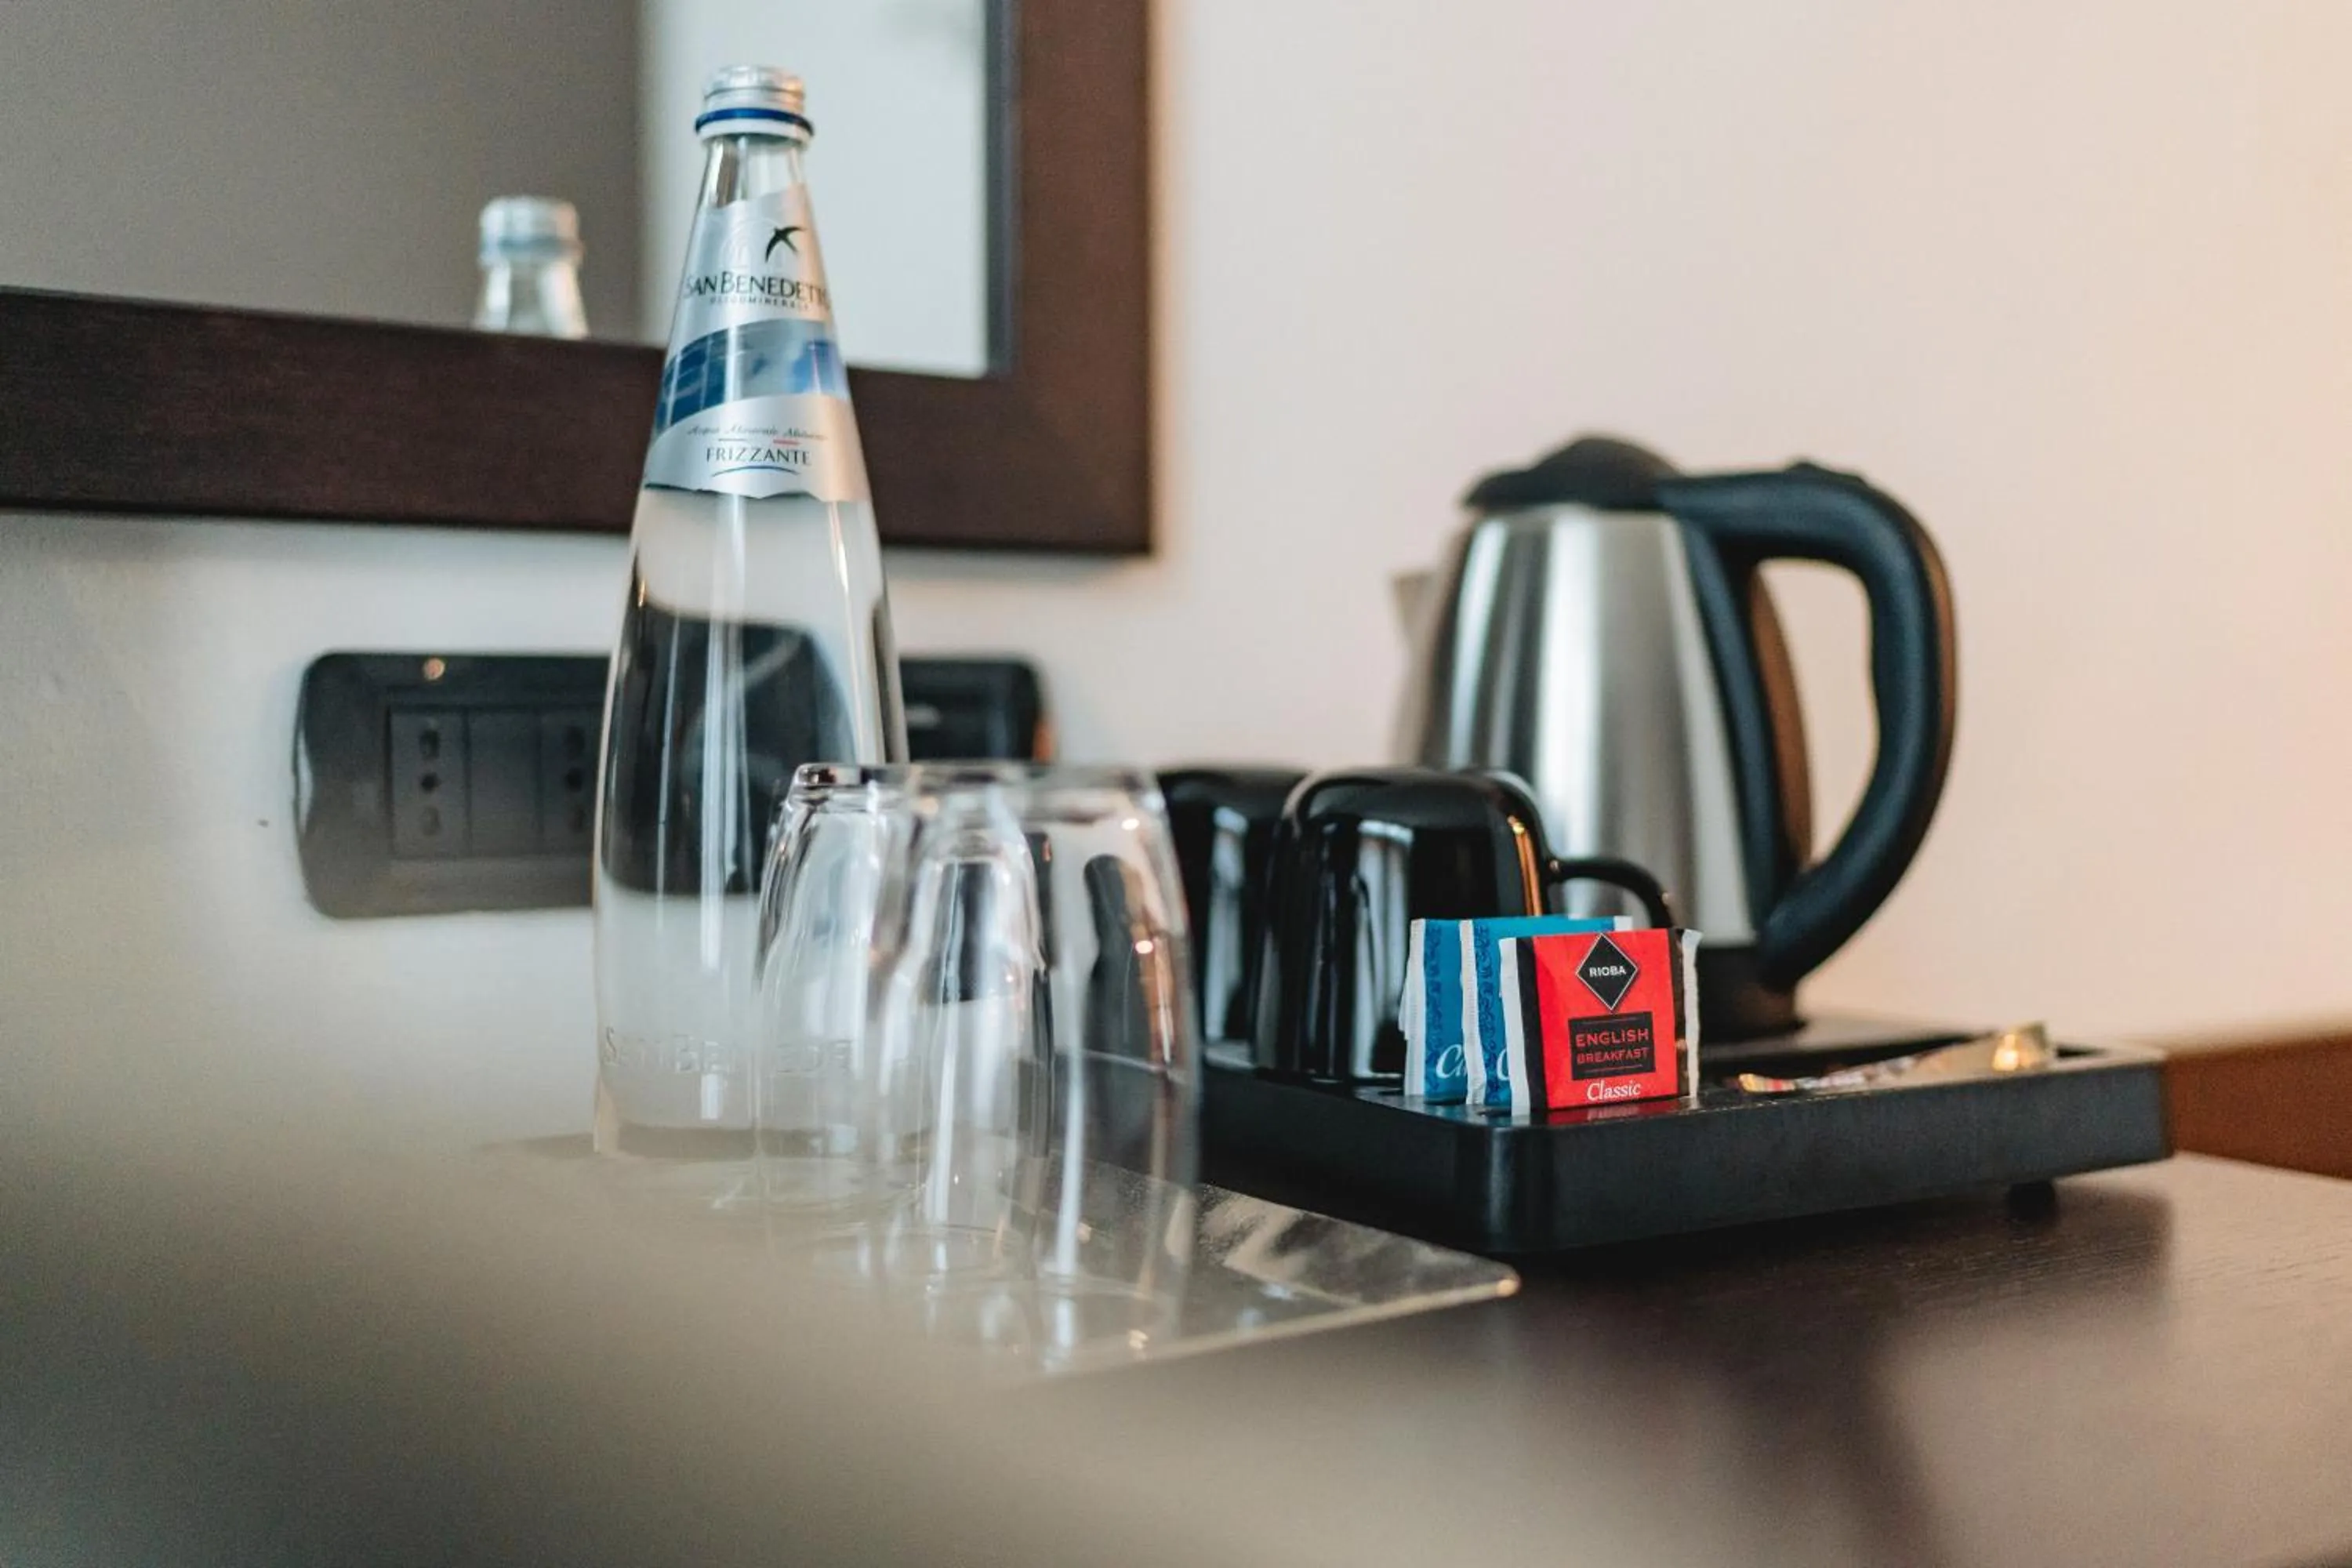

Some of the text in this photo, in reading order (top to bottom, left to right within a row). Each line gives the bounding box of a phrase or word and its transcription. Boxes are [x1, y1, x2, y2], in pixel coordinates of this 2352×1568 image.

[683, 274, 717, 299] SAN
[706, 448, 811, 466] FRIZZANTE
[1589, 965, 1627, 978] RIOBA
[1575, 1029, 1649, 1047] ENGLISH
[1577, 1047, 1649, 1065] BREAKFAST
[1587, 1080, 1642, 1102] Classic
